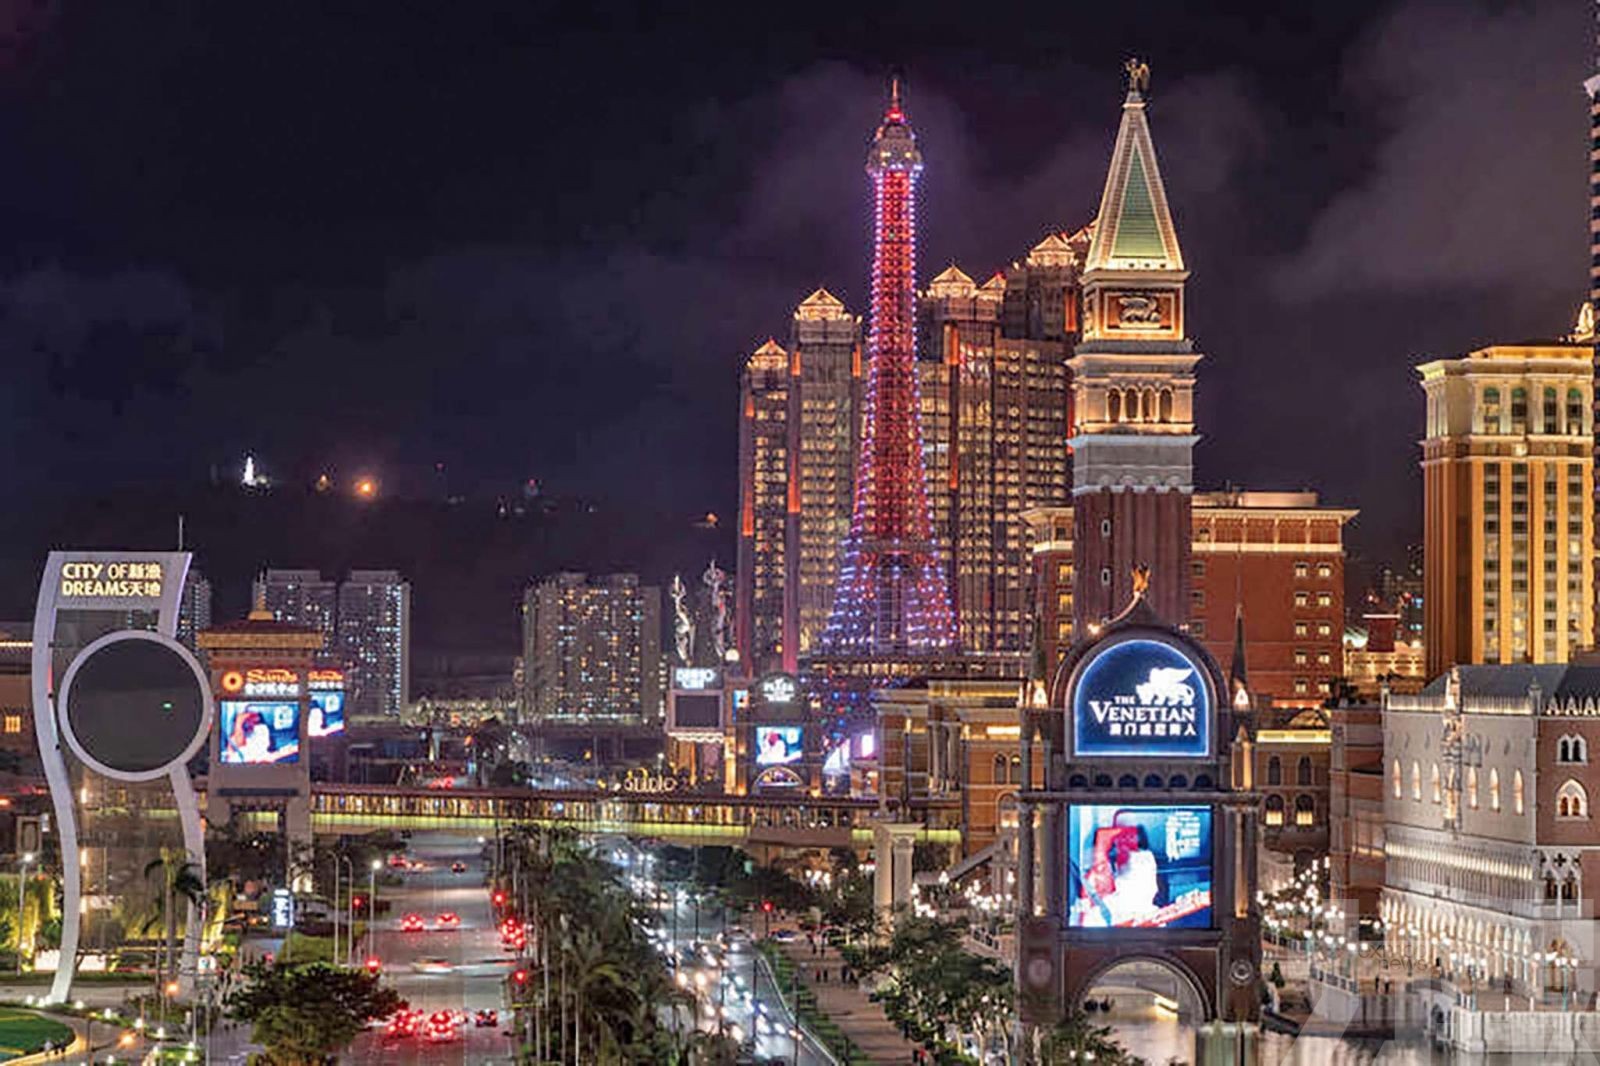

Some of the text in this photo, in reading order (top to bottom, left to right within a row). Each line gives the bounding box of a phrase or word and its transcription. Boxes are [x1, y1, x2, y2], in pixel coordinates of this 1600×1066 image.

[62, 563, 103, 578] CITY
[107, 563, 128, 579] OF
[62, 581, 128, 596] DREAMS
[1114, 695, 1136, 705] THE
